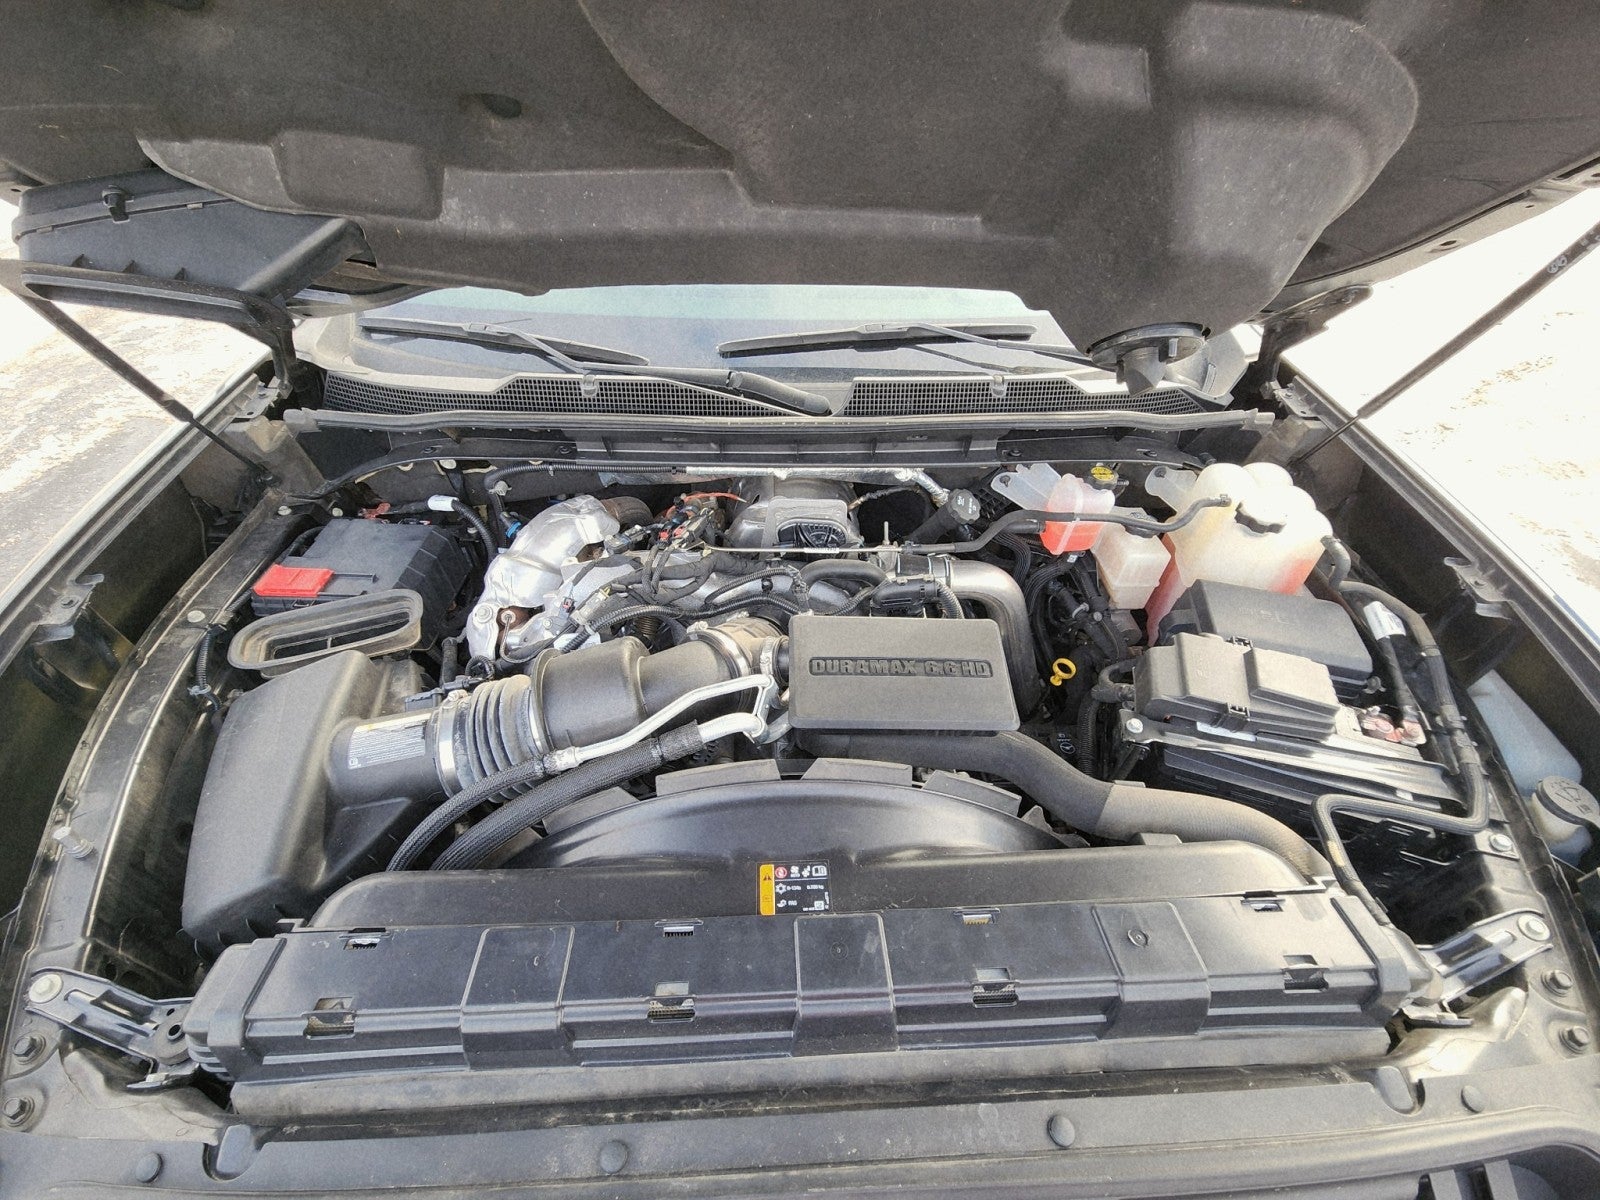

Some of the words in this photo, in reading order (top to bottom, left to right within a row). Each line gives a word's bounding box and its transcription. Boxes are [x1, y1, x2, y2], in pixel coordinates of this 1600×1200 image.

[811, 658, 917, 675] DURAMAX
[924, 660, 957, 675] 6.6
[961, 661, 988, 676] HD
